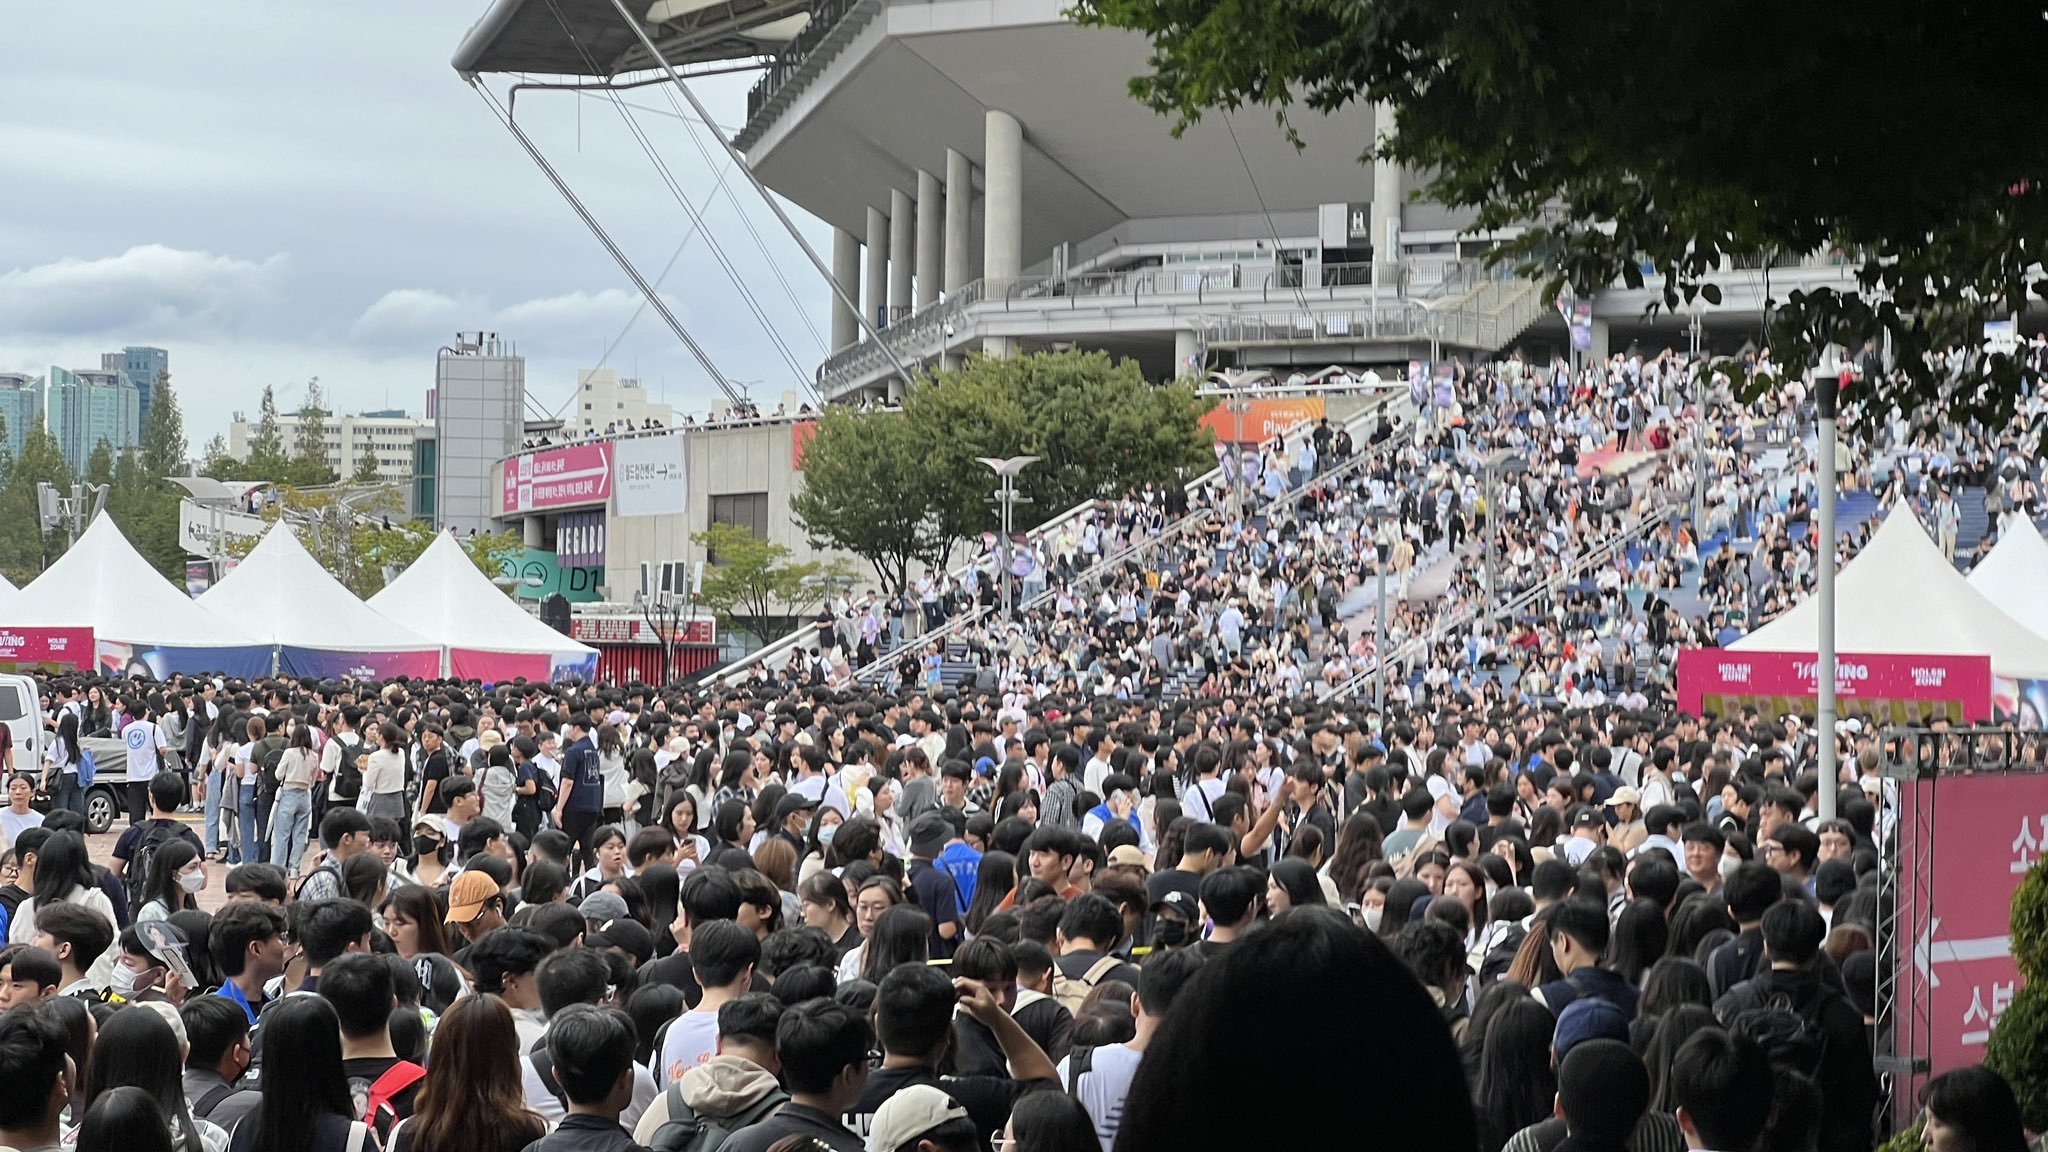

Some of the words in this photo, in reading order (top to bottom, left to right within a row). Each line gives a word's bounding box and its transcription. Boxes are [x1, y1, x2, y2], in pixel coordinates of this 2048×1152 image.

[570, 567, 598, 593] D1
[1722, 672, 1747, 683] ZONE
[1915, 676, 1942, 686] ZONE
